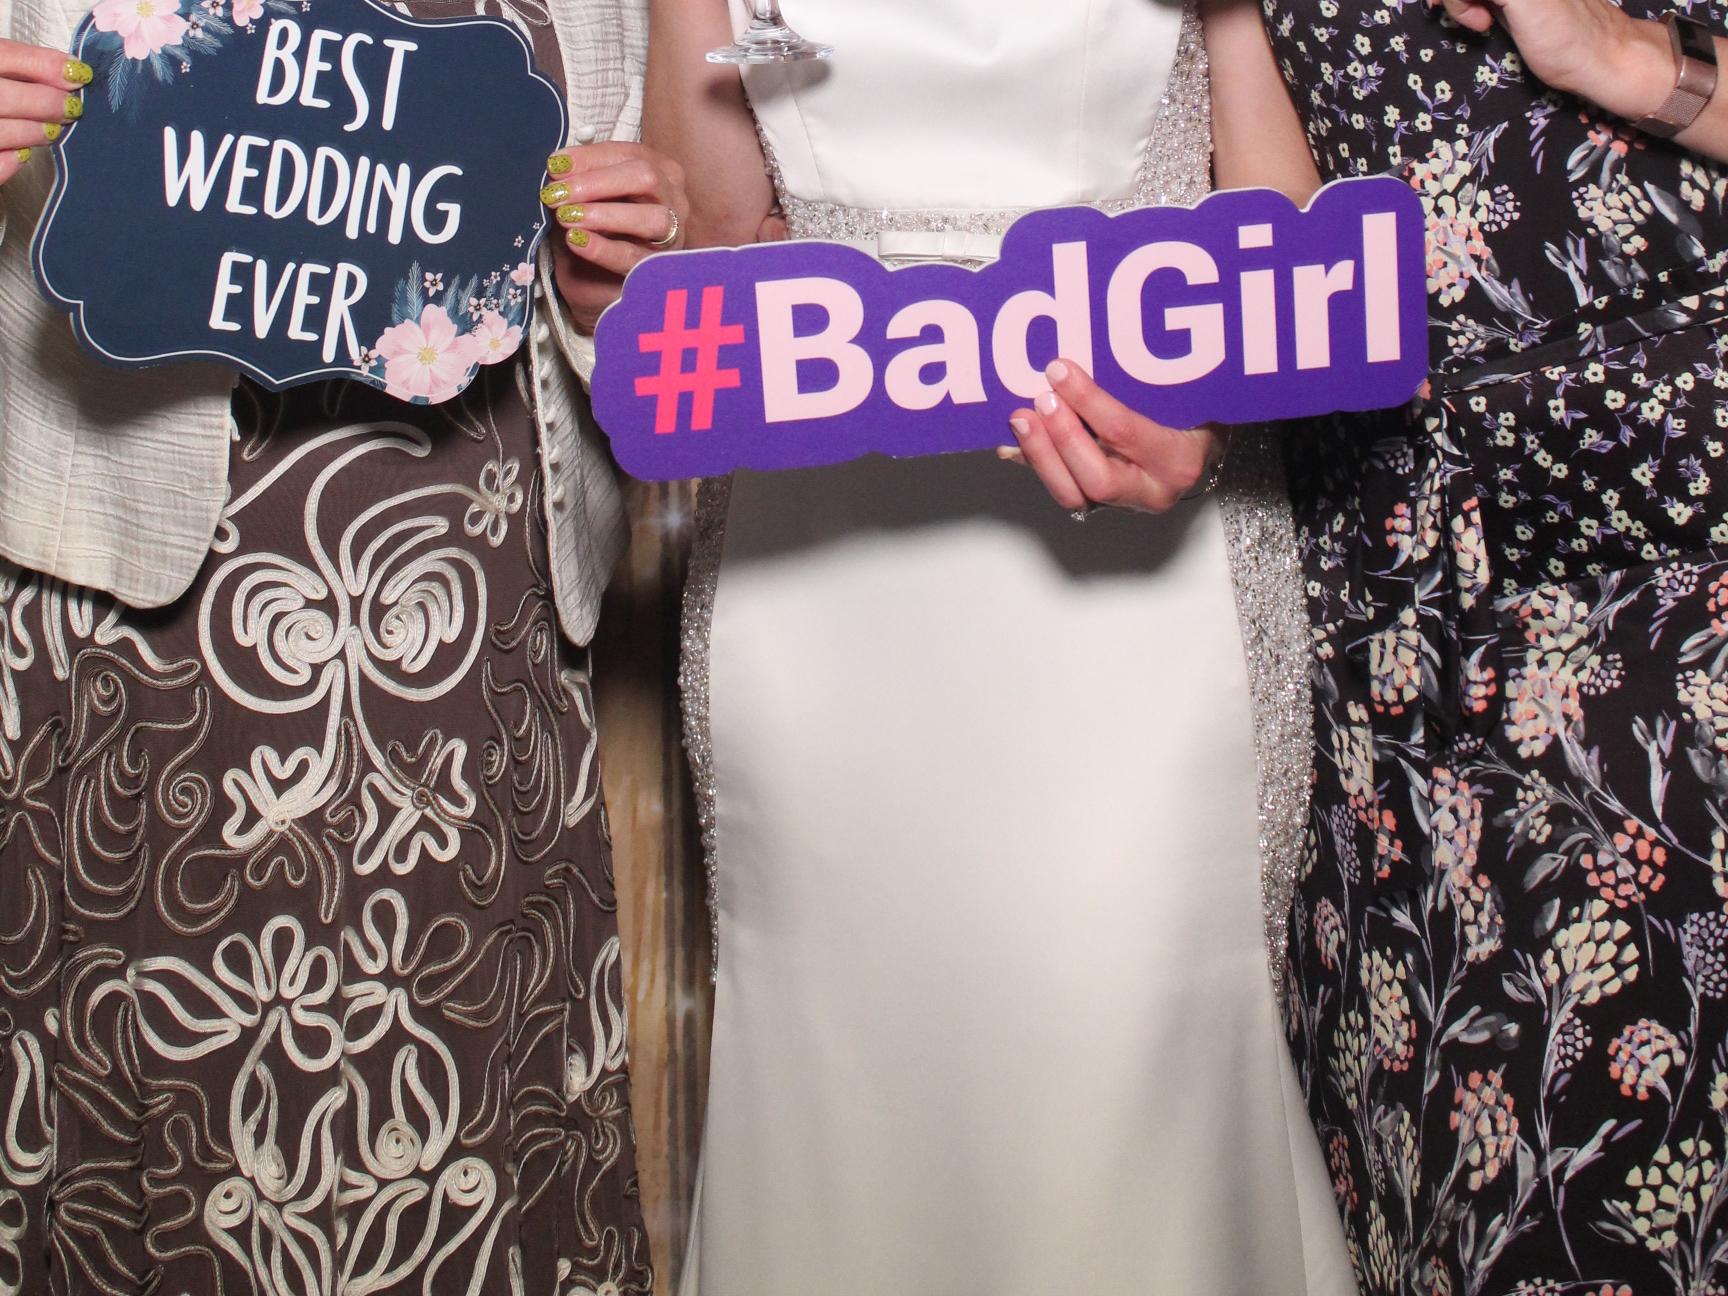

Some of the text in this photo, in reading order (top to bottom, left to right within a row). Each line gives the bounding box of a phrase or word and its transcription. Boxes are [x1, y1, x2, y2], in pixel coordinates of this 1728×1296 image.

[256, 18, 418, 132] BEST
[163, 125, 464, 246] WEDDING
[208, 251, 368, 364] EVER
[634, 212, 1401, 434] #BadGirl
